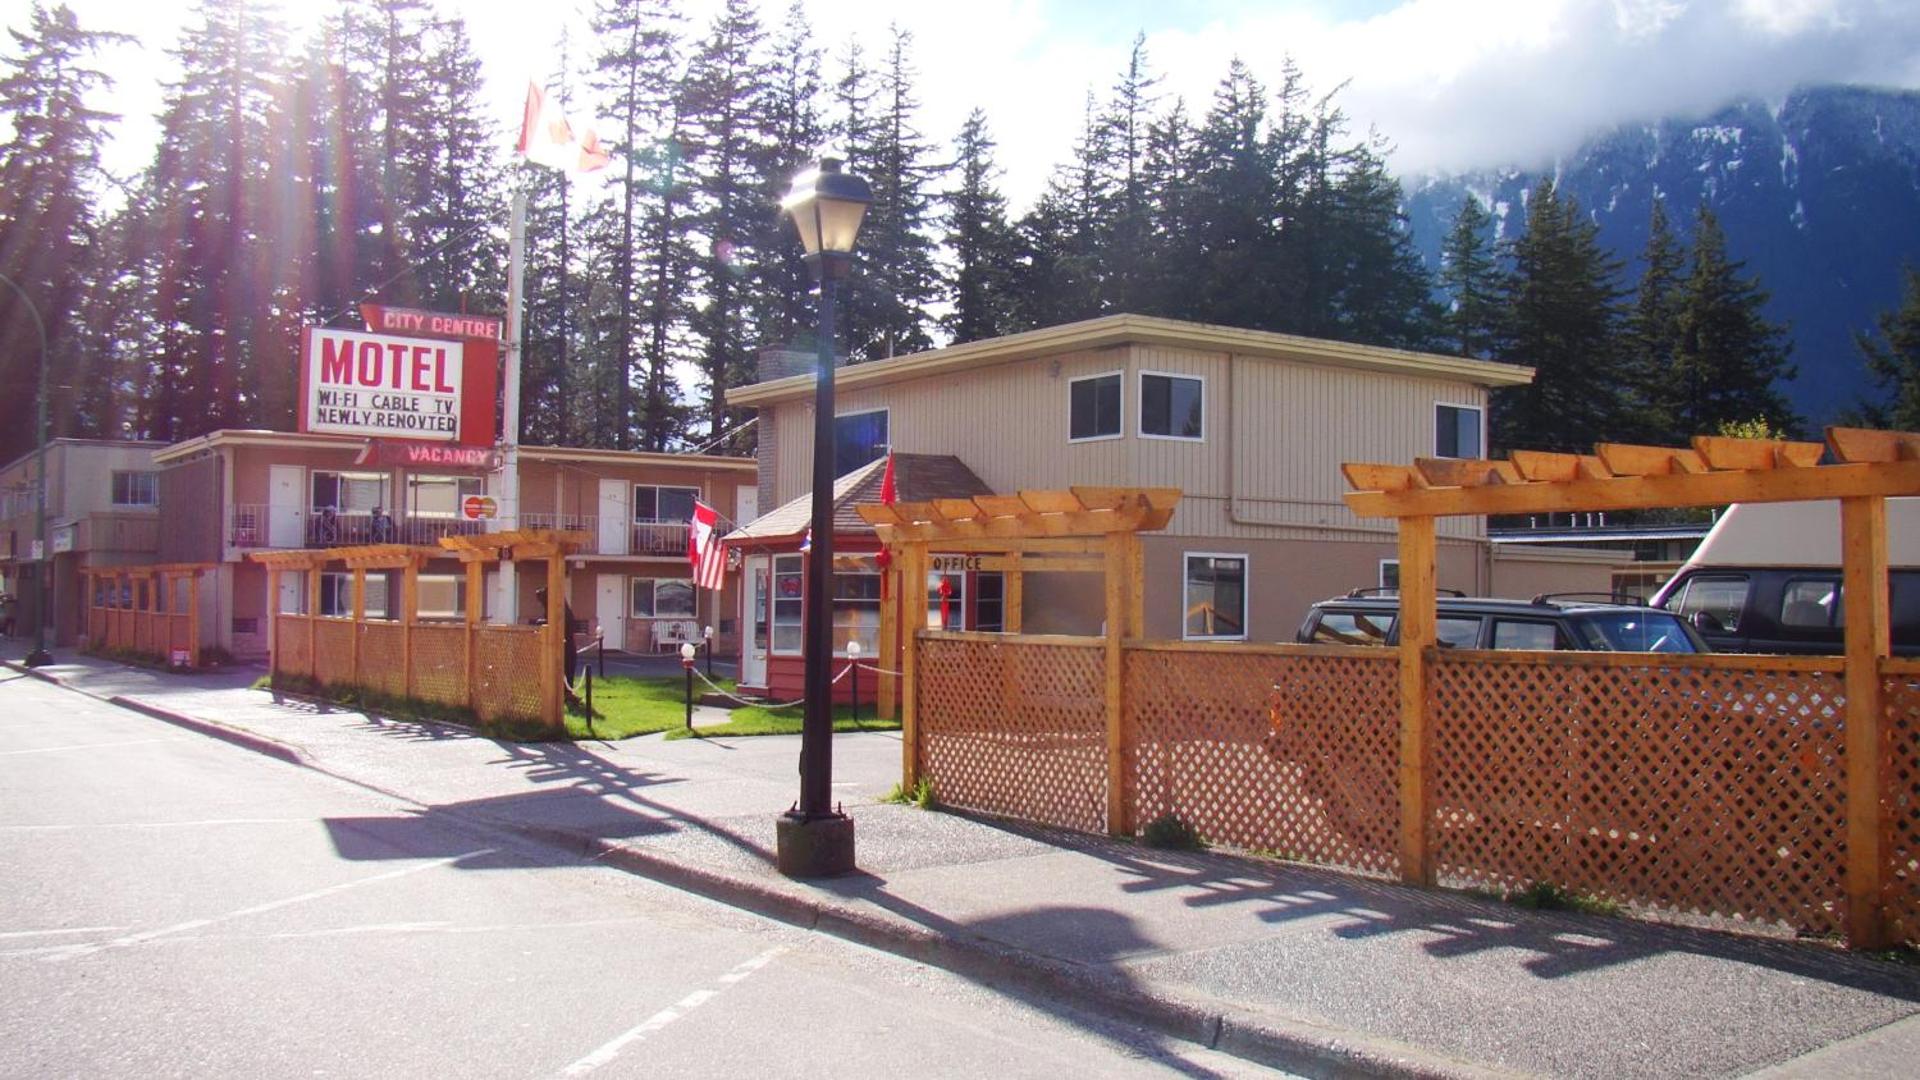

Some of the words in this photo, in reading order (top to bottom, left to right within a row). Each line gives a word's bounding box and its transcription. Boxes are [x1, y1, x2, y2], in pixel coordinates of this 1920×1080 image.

[383, 312, 423, 331] CITY
[431, 317, 495, 337] CENTRE
[321, 337, 455, 394] MOTEL
[318, 389, 358, 407] WI-FI
[371, 394, 420, 412] CABLE
[435, 399, 453, 414] TV
[408, 445, 488, 463] VACANCY
[933, 557, 982, 570] OFFICE
